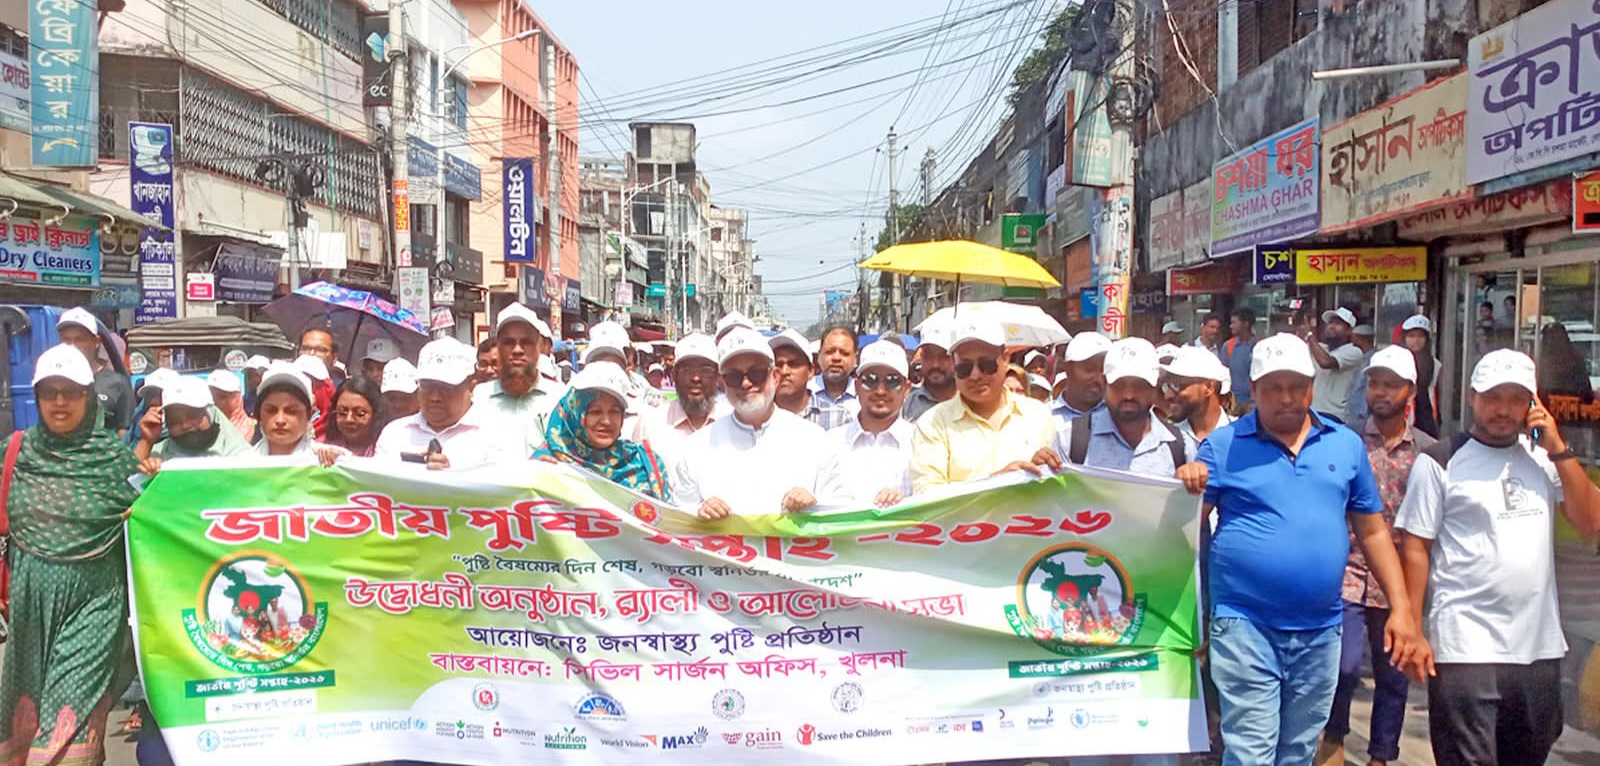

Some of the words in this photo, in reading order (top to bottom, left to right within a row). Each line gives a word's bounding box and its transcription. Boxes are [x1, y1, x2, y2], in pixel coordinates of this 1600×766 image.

[1215, 146, 1268, 203] চশমা
[1276, 126, 1314, 179] ঘর
[1329, 114, 1415, 199] হাসান
[1216, 195, 1268, 226] CHASHMA
[1271, 178, 1313, 208] GHAR
[13, 220, 39, 242] ড্রাই
[45, 226, 91, 248] ক্লিনার্স
[0, 248, 26, 268] Dry
[33, 251, 92, 270] Cleaners
[1307, 253, 1360, 273] হাসান
[205, 494, 450, 538] জাতীয়
[461, 501, 623, 549] পুষ্টি
[495, 556, 560, 573] বৈষম্যের
[565, 559, 596, 575] দিন
[603, 558, 643, 573] শেষ,
[346, 574, 472, 613] উদ্বোধনী
[479, 584, 606, 622] অনুষ্ঠান,
[708, 589, 730, 612] ও
[467, 627, 587, 653] আয়োজনেঃ
[597, 632, 701, 657] জনস্বাস্থ্য
[710, 629, 756, 657] পুষ্টি
[765, 620, 863, 649] প্রতিষ্ঠান
[430, 653, 552, 677] বাস্তবায়নে:
[563, 659, 643, 683] সিভিল
[654, 656, 728, 682] সার্জন
[737, 655, 827, 680] অফিস,
[838, 648, 908, 676] খুলনা
[370, 717, 411, 732] unicef
[817, 732, 837, 742] Save
[839, 731, 854, 740] the
[855, 728, 892, 740] Children
[544, 731, 587, 743] Nutrition
[600, 739, 624, 747] World
[626, 739, 649, 748] Vision
[662, 733, 695, 749] MAX
[744, 727, 782, 748] gain
